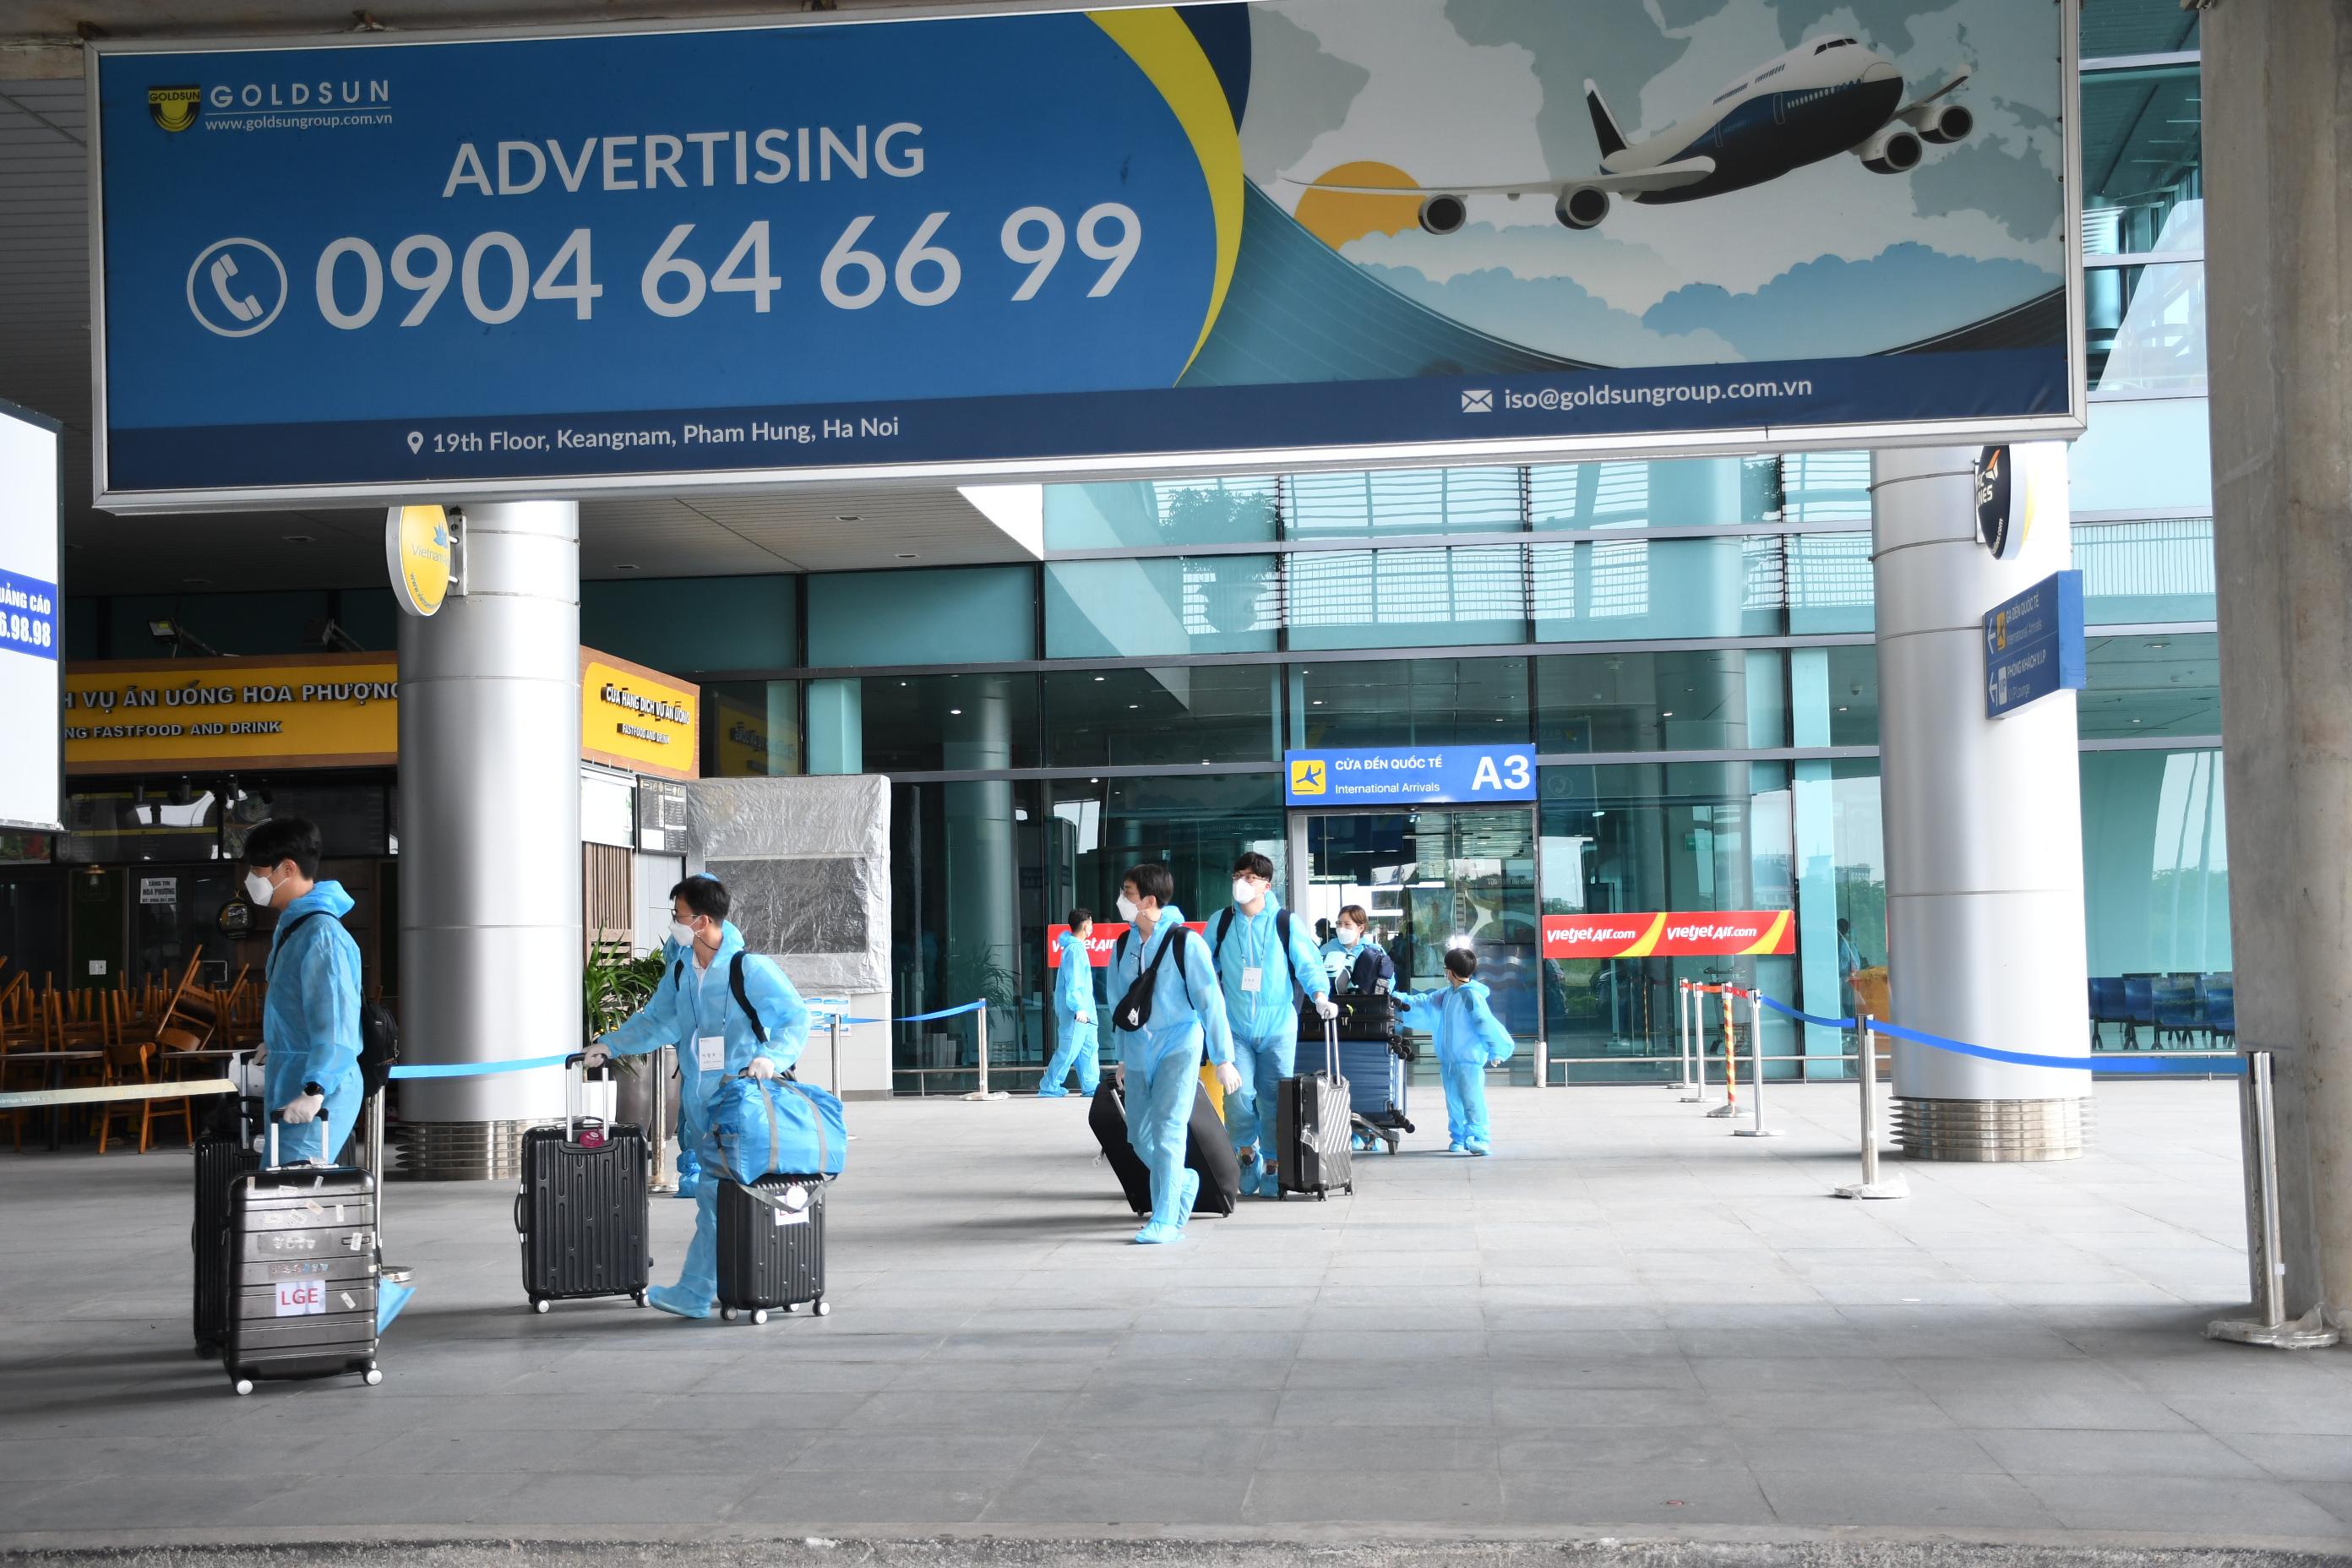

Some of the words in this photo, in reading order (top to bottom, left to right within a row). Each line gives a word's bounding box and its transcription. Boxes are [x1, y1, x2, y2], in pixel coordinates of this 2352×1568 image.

[150, 92, 199, 101] GOLDSUN
[210, 79, 390, 107] GOLDSUN
[205, 112, 393, 132] www.goldsungroup.com.vn
[442, 122, 925, 199] ADVERTISING
[315, 228, 603, 330] 0904
[640, 220, 782, 318] 64
[819, 212, 961, 310] 66
[1000, 202, 1142, 302] 99
[1505, 380, 1812, 411] iso@goldsungroup.com.vn
[433, 431, 482, 453] 19th
[490, 430, 550, 455] Floor,
[558, 428, 677, 451] Keangnam,
[683, 424, 744, 445] Pham
[752, 422, 816, 444] Hung,
[824, 419, 853, 439] Ha
[861, 416, 899, 438] Noi
[29, 594, 52, 615] CÁO
[82, 690, 117, 714] VỤ
[123, 685, 159, 707] ĂN
[165, 680, 237, 707] UỐNG
[242, 685, 295, 704] HOA
[93, 724, 184, 738] FASTFOOD
[190, 722, 226, 736] AND
[230, 721, 283, 734] DRINK
[622, 723, 646, 739] FASTFOOD
[645, 730, 656, 742] AND
[1335, 758, 1361, 770] CỬA
[1364, 755, 1389, 770] ĐẾN
[1391, 754, 1426, 770] QUỐC
[1427, 754, 1442, 769] TẾ
[1471, 754, 1531, 791] A3
[1335, 782, 1399, 794] International
[1402, 782, 1440, 793] Arrivals
[280, 1288, 319, 1306] LGE
